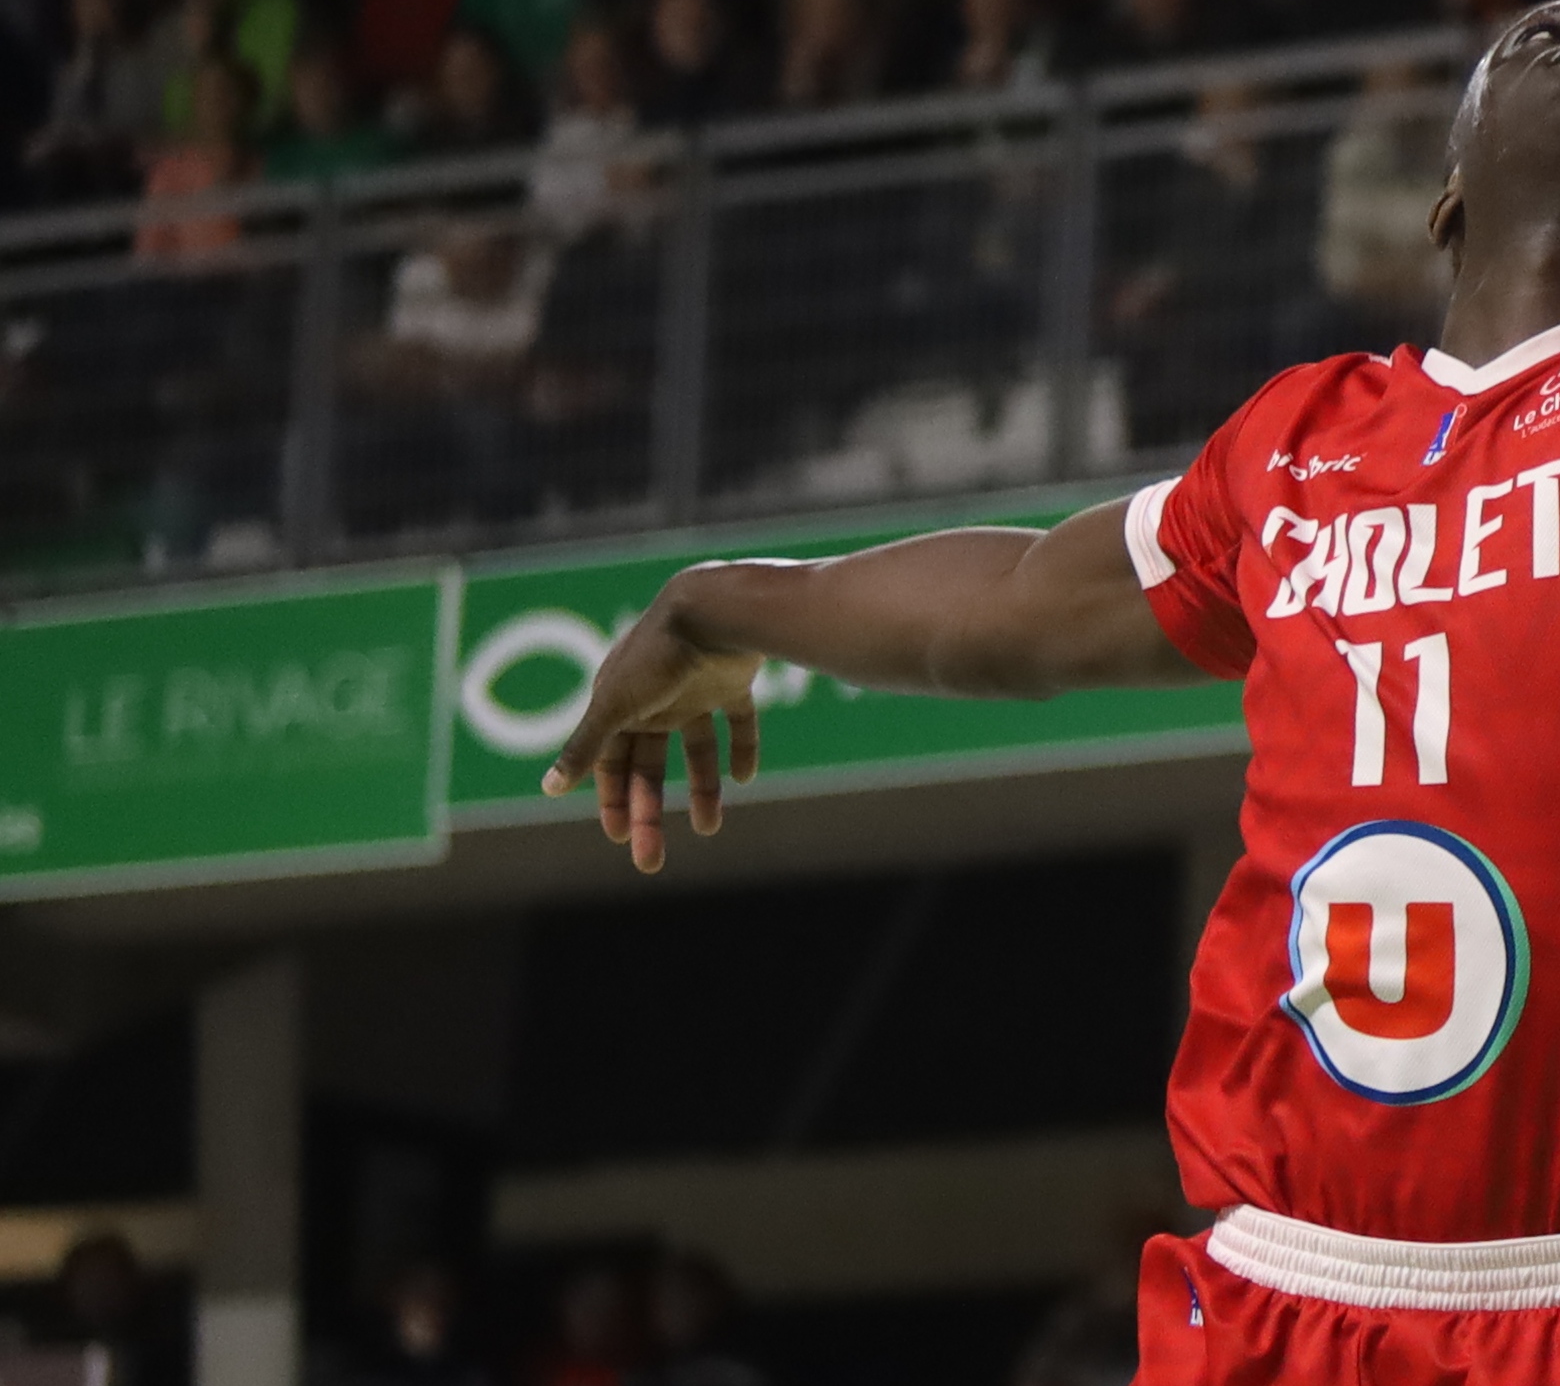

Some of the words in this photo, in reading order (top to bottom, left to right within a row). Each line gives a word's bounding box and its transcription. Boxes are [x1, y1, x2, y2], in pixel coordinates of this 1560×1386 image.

[1513, 410, 1537, 431] Le
[1336, 632, 1451, 787] 11
[1324, 901, 1456, 1040] U
